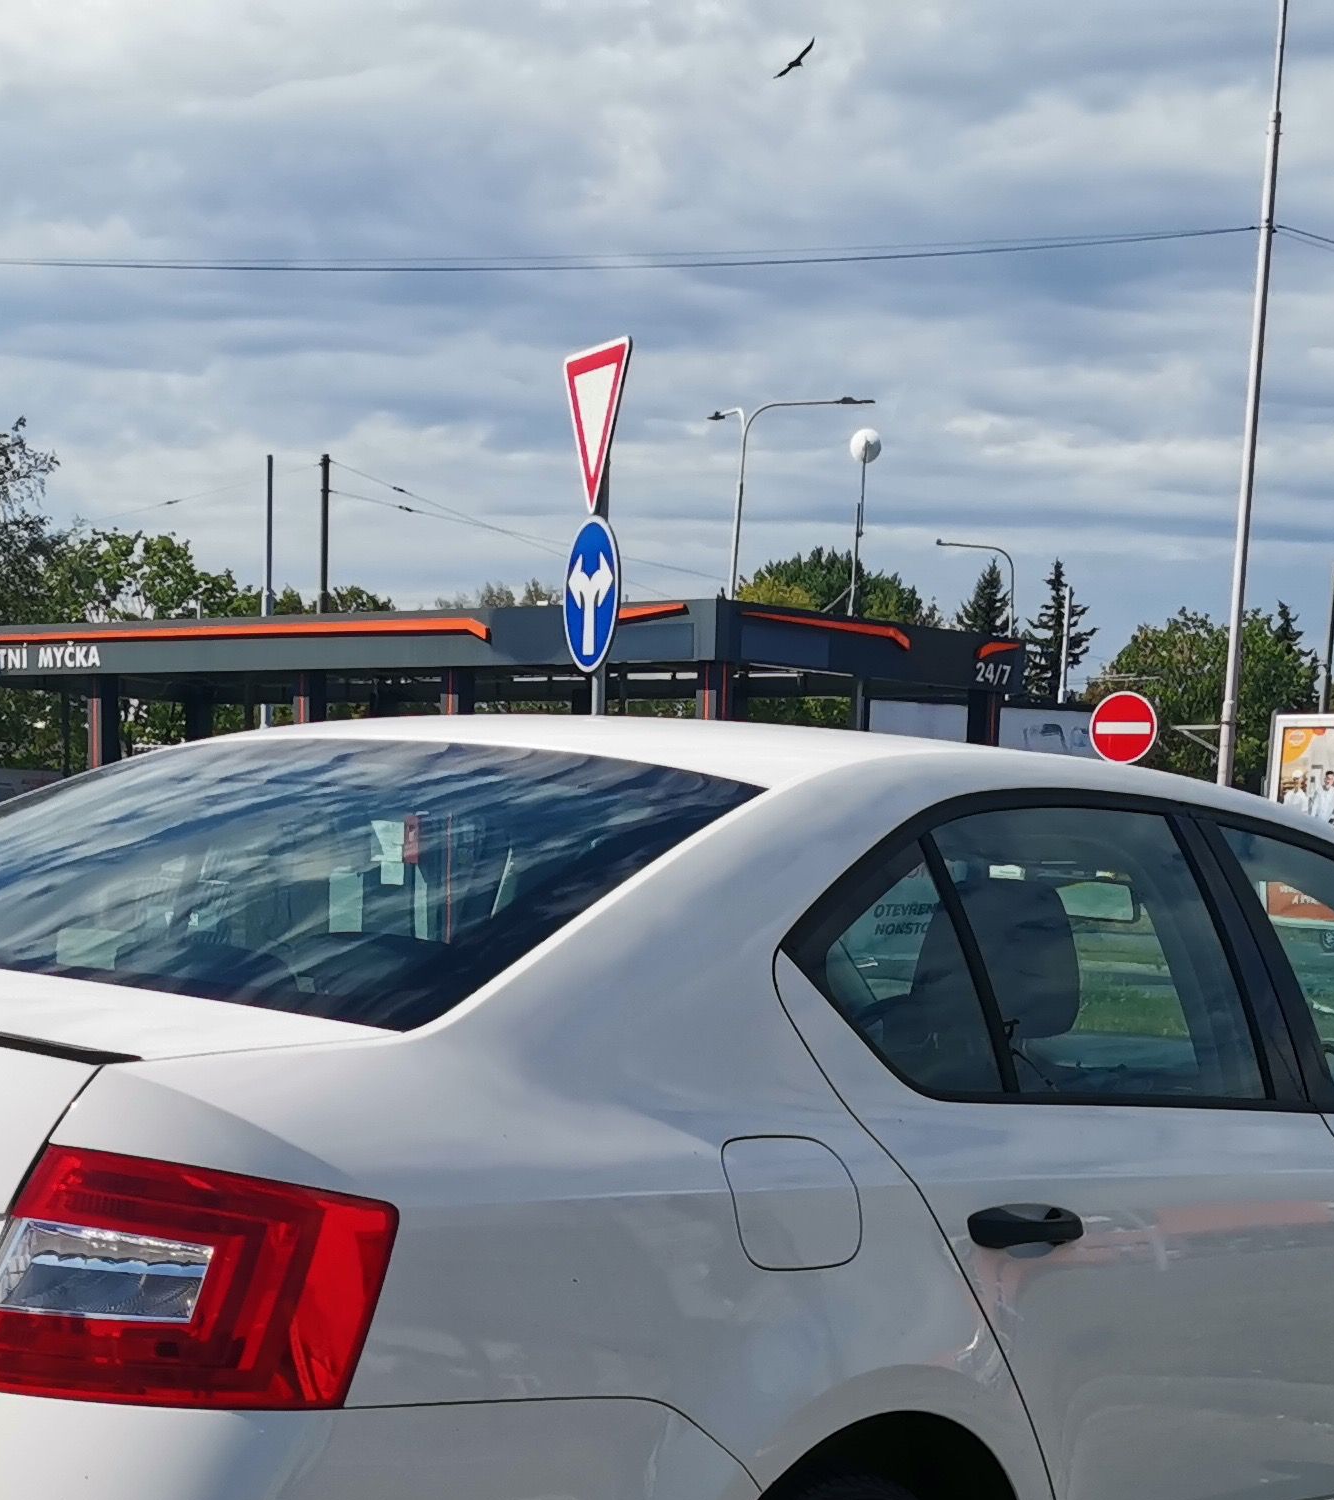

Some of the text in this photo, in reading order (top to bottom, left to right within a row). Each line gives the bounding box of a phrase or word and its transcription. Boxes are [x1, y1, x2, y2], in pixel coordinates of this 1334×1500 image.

[38, 641, 101, 668] MYČKA
[975, 661, 1011, 686] 24/7
[873, 901, 938, 918] OTEVŘEN
[874, 921, 928, 936] NONSTO
